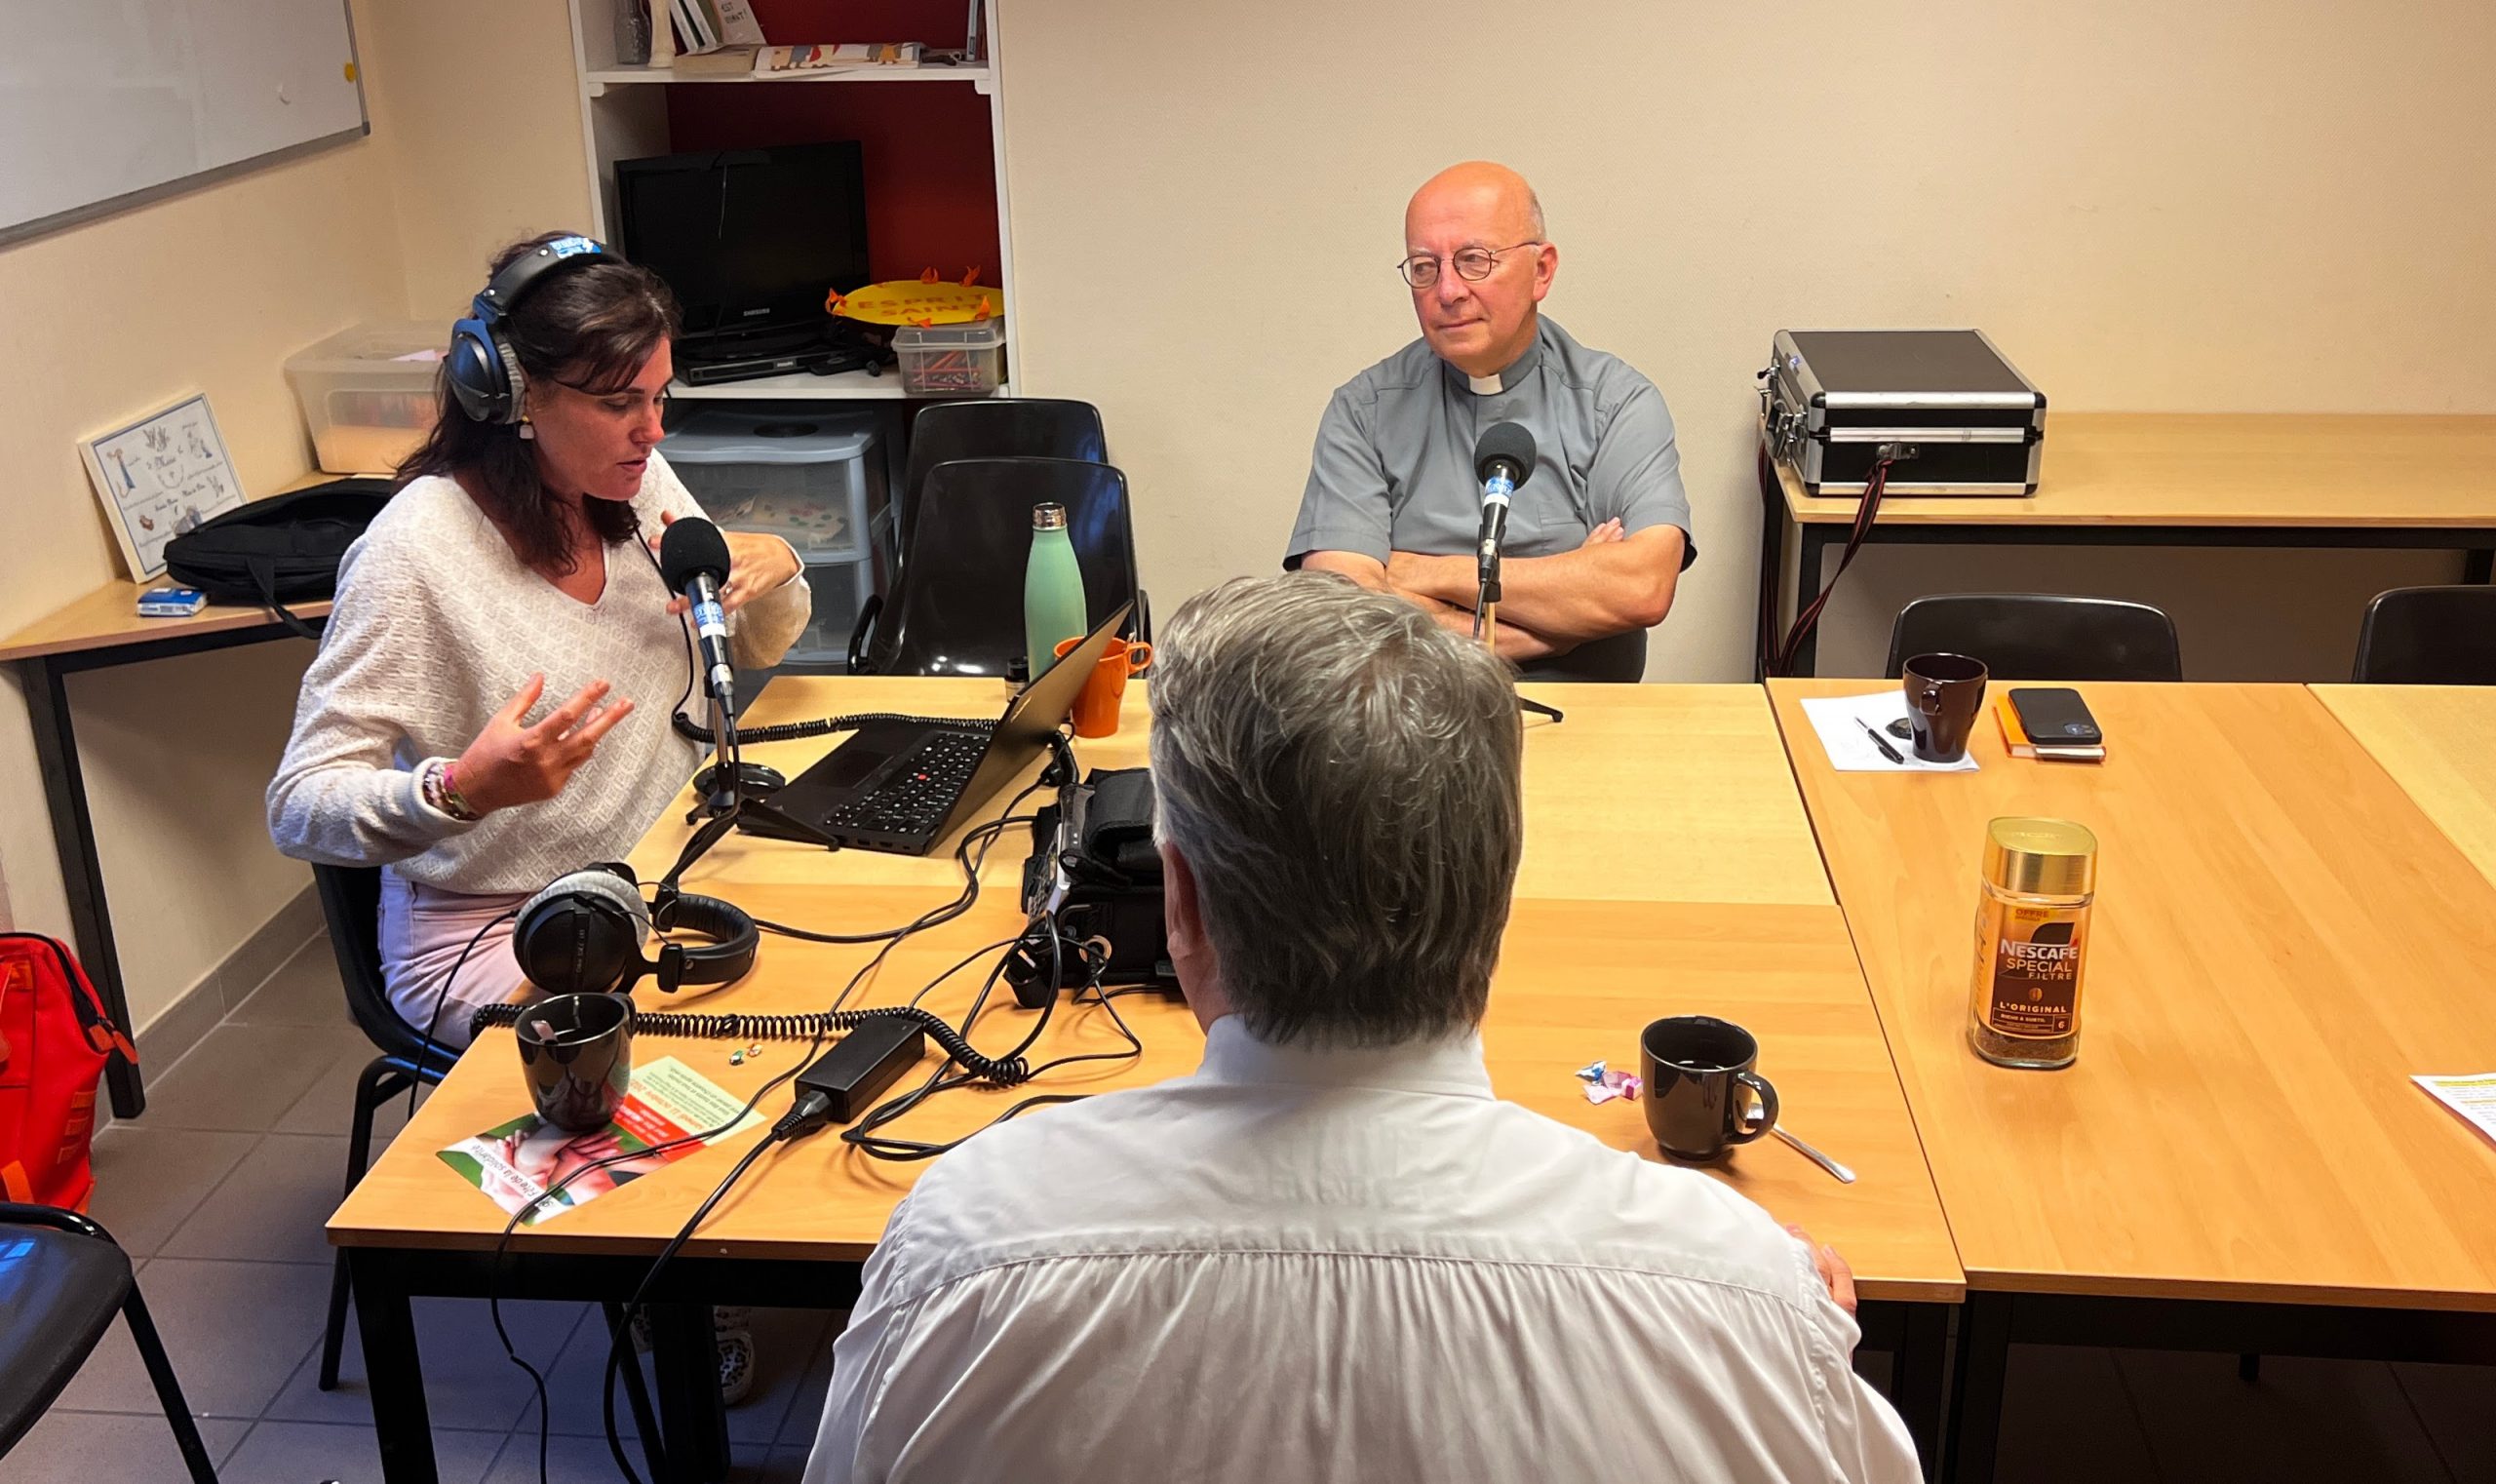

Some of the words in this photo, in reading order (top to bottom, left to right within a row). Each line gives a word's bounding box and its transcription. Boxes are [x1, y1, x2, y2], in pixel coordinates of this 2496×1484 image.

[857, 293, 983, 309] ESPRIT
[880, 303, 979, 317] SAINT
[2015, 908, 2048, 918] OFFRE
[2007, 957, 2072, 973] SPECIAL
[2028, 971, 2072, 981] FILTRE
[2000, 1001, 2066, 1013] L'ORIGINAL
